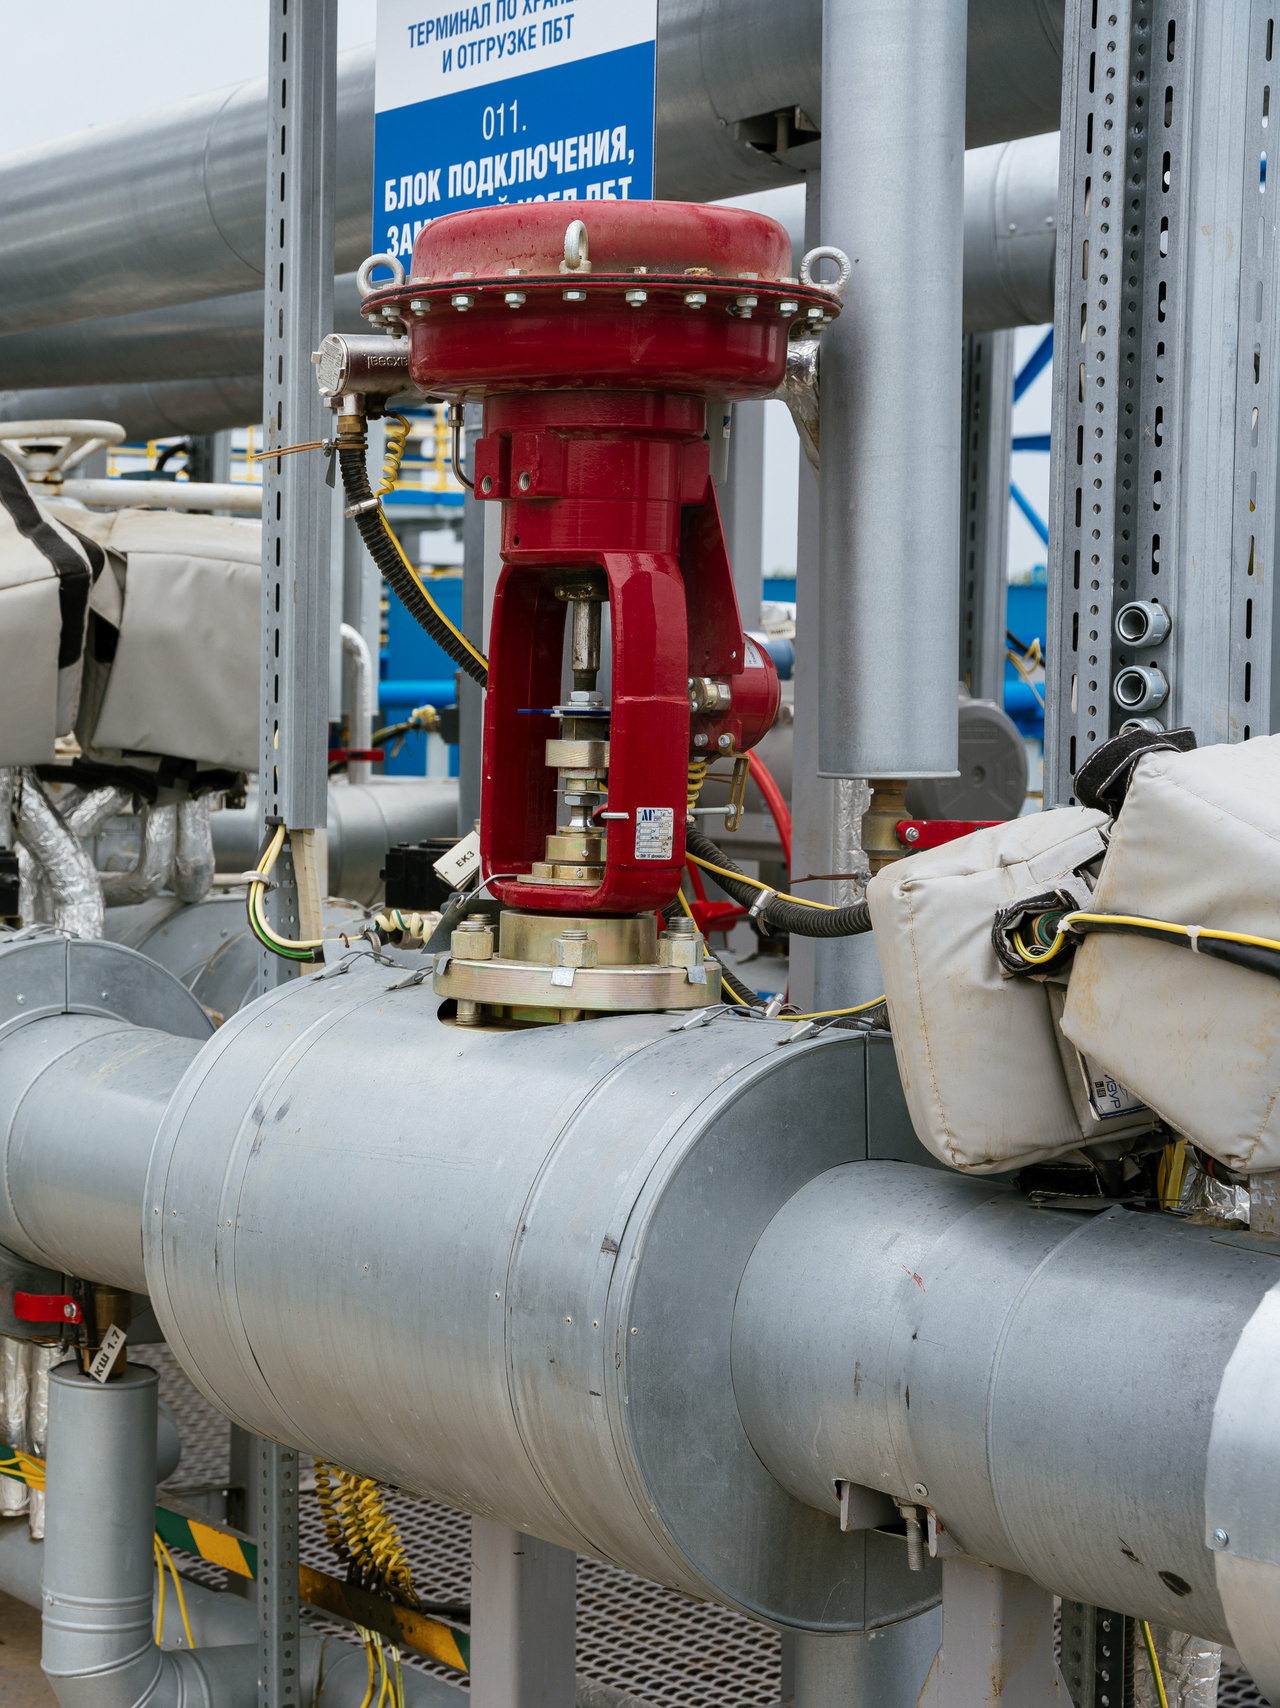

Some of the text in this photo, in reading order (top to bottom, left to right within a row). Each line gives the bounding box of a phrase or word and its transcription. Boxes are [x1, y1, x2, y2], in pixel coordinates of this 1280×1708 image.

[408, 2, 491, 48] ТЕРМИНАЛ
[496, 0, 517, 23] ПО
[442, 13, 575, 74] И ОТГРУЗКЕ ПБТ
[482, 99, 527, 140] 011.
[384, 125, 635, 212] БЛОК ПОДКЛЮЧЕНИЯ,
[367, 356, 409, 369] axseal
[94, 1330, 120, 1378] КШ 1.7
